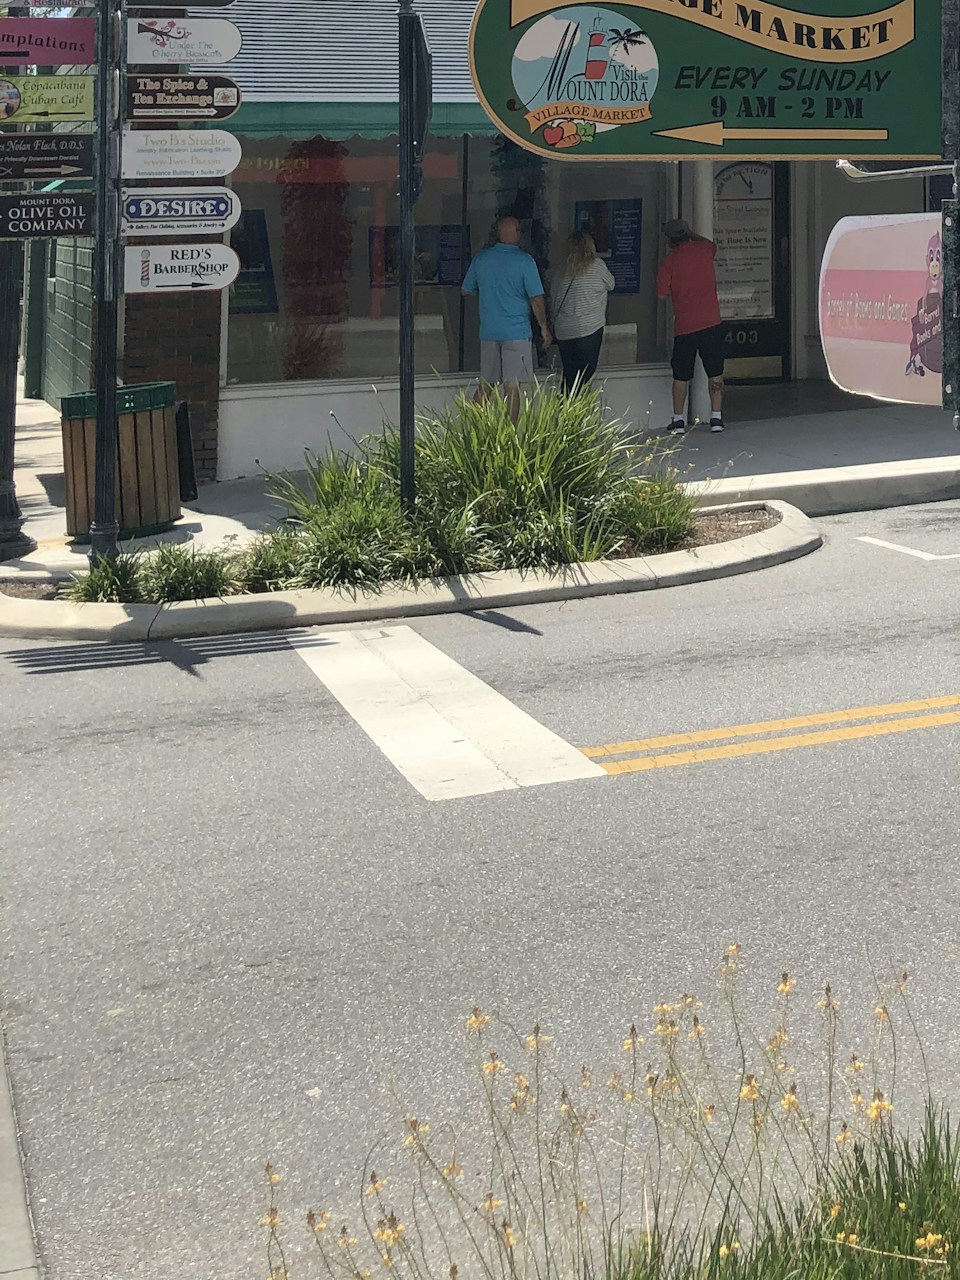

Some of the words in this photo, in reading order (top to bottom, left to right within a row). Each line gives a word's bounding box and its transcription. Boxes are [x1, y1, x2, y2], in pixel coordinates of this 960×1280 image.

[734, 2, 895, 51] MARKET
[609, 64, 638, 81] Visit
[674, 65, 766, 91] EVERY
[777, 65, 892, 93] SUNDAY
[22, 79, 86, 93] Copacabana
[136, 78, 161, 90] The
[162, 78, 194, 93] Spice
[196, 78, 209, 90] &
[610, 81, 649, 102] DORA
[22, 93, 57, 105] Cuban
[132, 92, 154, 105] Tea
[155, 92, 213, 107] Exchange
[532, 105, 590, 122] VILLAGE
[592, 107, 645, 120] MARKET
[711, 95, 727, 118] 9
[736, 96, 777, 119] AM
[802, 96, 816, 119] 2
[825, 97, 865, 119] PM
[6, 140, 31, 151] Nolan
[60, 140, 85, 150] D.D.S.
[143, 134, 167, 146] Two
[187, 133, 226, 146] Studio
[20, 198, 51, 206] MOUNT
[139, 199, 218, 216] DESIRE
[8, 207, 55, 219] OLIVE
[59, 206, 86, 217] OIL
[8, 218, 86, 232] COMPANY
[170, 248, 212, 261] RED'S
[724, 330, 758, 344] 403
